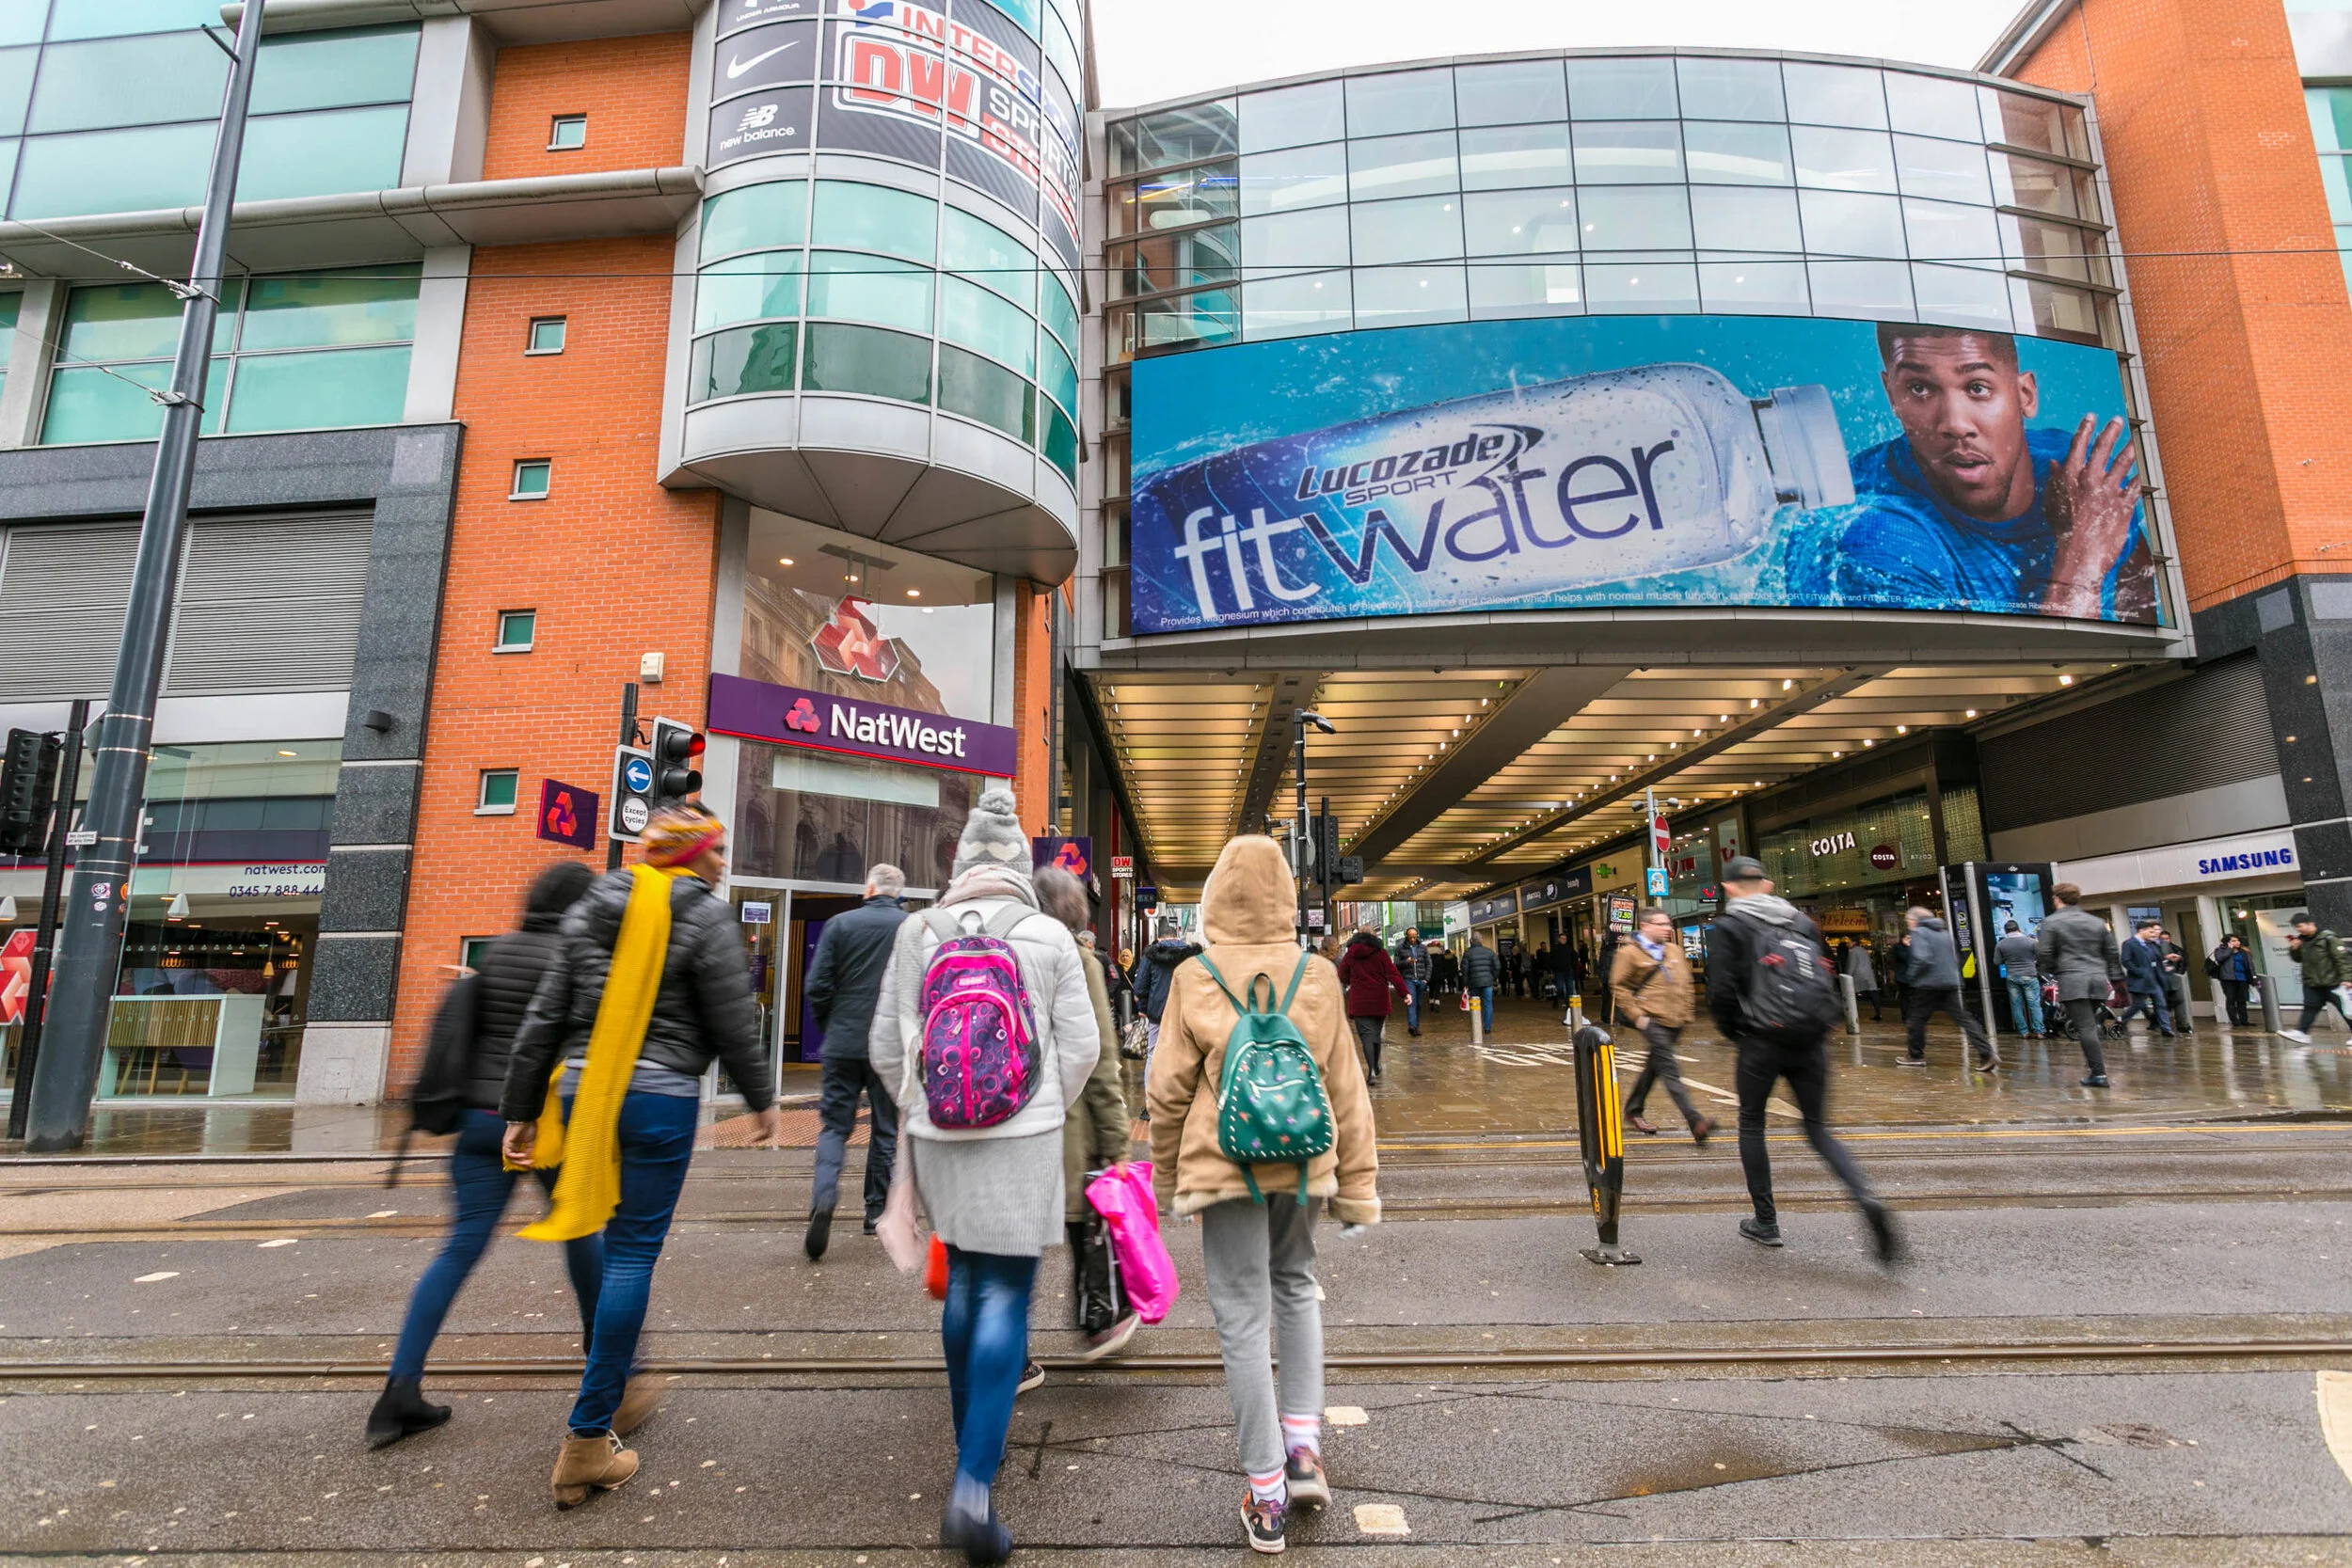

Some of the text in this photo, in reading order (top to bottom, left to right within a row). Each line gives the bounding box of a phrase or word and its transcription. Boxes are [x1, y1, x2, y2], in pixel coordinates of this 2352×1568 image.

[851, 40, 975, 129] DW
[720, 126, 795, 150] new balance
[1295, 433, 1504, 501] Lucozade
[1344, 470, 1458, 508] SPORT
[1160, 616, 1201, 627] Provides
[1262, 607, 1291, 618] which
[1292, 604, 1346, 616] contributes
[1349, 602, 1359, 611] to
[1460, 595, 1478, 607] and
[1522, 594, 1553, 605] which
[1555, 593, 1582, 604] helps
[1585, 592, 1606, 602] with
[1608, 591, 1644, 601] normal
[1646, 591, 1682, 601] muscle
[1848, 594, 1862, 602] and
[831, 703, 967, 759] NatWest
[625, 805, 646, 816] Except
[625, 816, 644, 825] cycles
[1811, 832, 1856, 857] COSTA
[1872, 853, 1896, 862] COSTA
[2198, 847, 2293, 875] SAMSUNG
[229, 884, 325, 897] 0345 7 888 44
